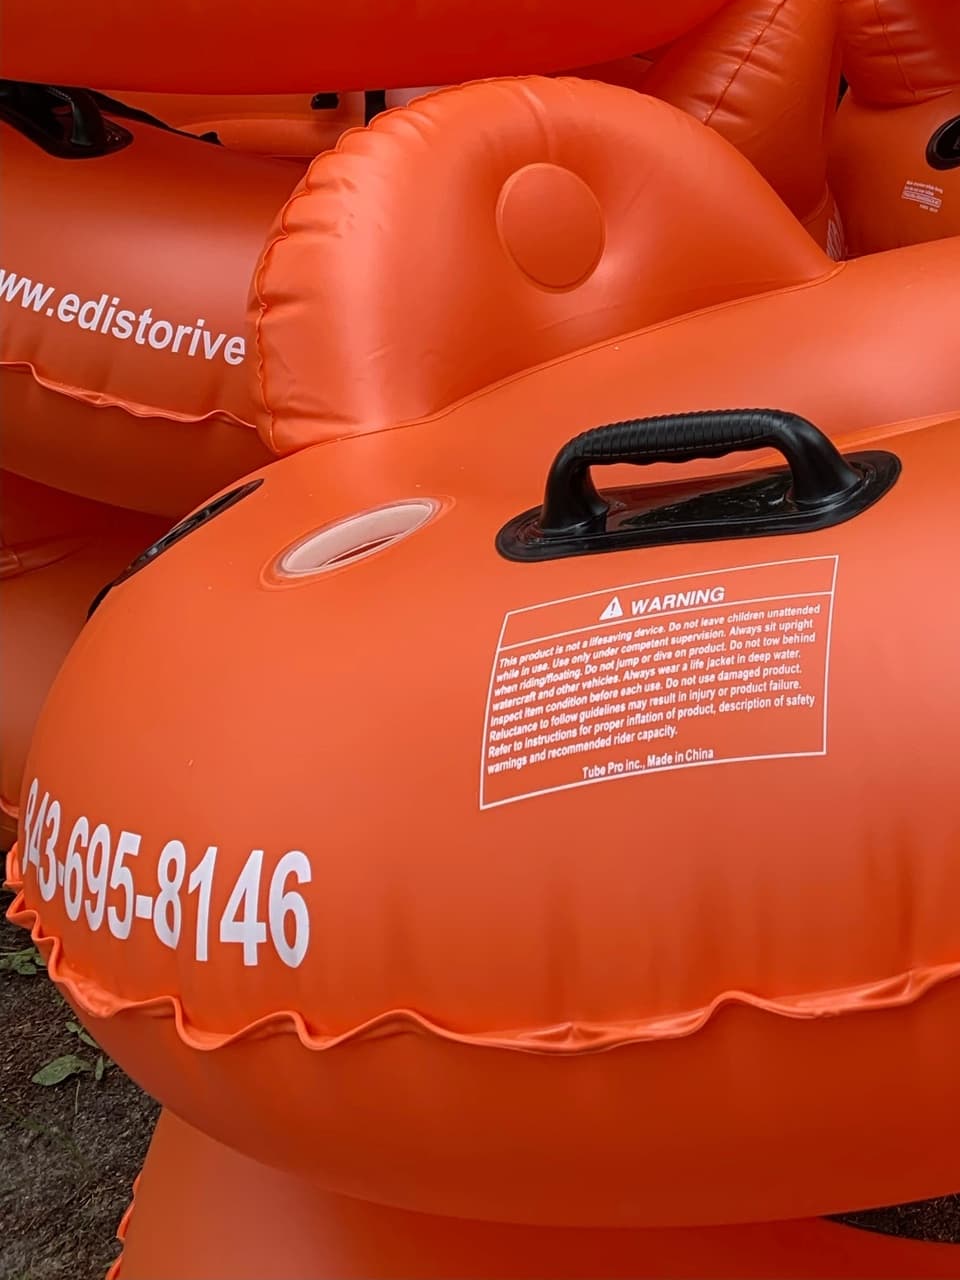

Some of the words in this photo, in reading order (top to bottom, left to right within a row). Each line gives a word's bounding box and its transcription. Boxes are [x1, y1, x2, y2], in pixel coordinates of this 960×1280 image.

[631, 587, 725, 615] WARNING
[495, 683, 517, 696] when
[585, 664, 597, 675] Do
[600, 662, 614, 671] not
[616, 657, 639, 669] jump
[642, 655, 651, 663] or
[654, 650, 672, 660] dive
[675, 649, 686, 658] on
[730, 640, 742, 650] Do
[745, 639, 760, 648] not
[763, 638, 780, 646] tow
[783, 633, 815, 644] behind
[497, 669, 519, 682] while
[521, 666, 529, 676] in
[552, 658, 569, 668] Use
[572, 653, 590, 664] only
[593, 647, 618, 660] under
[621, 638, 668, 654] competent
[729, 625, 762, 638] Always
[764, 622, 776, 632] sit
[779, 619, 813, 632] upright
[500, 656, 517, 668] This
[519, 649, 553, 664] product
[555, 646, 563, 654] is
[565, 643, 580, 652] not
[590, 631, 632, 647] lifesaving
[669, 622, 681, 632] Do
[684, 620, 698, 629] not
[701, 617, 724, 626] leave
[728, 610, 764, 623] children
[767, 604, 820, 618] unattended
[493, 692, 536, 711] watercraft
[538, 688, 554, 699] and
[556, 682, 579, 695] other
[623, 667, 655, 681] Always
[658, 662, 679, 675] wear
[690, 659, 704, 669] life
[706, 655, 735, 669] jacket
[737, 654, 745, 663] in
[748, 650, 770, 662] deep
[546, 696, 587, 712] condition
[590, 689, 618, 703] before
[620, 684, 642, 697] each
[666, 678, 678, 689] Do
[681, 675, 696, 685] not
[699, 675, 715, 683] use
[718, 668, 760, 681] damaged
[488, 744, 512, 758] Refer
[514, 741, 522, 750] to
[525, 730, 577, 750] instructions
[579, 724, 592, 735] for
[594, 719, 625, 733] proper
[627, 710, 663, 725] inflation
[666, 708, 676, 719] of
[719, 697, 771, 712] description
[774, 695, 784, 707] of
[786, 694, 815, 708] safety
[490, 724, 537, 742] Reluctance
[540, 720, 549, 728] to
[551, 714, 578, 726] follow
[579, 704, 625, 722] guidelines
[628, 700, 647, 713] may
[650, 691, 676, 705] result
[679, 690, 687, 699] in
[689, 686, 715, 701] injury
[718, 687, 728, 696] or
[731, 682, 767, 698] product
[488, 755, 527, 775] warnings
[530, 749, 546, 763] and
[548, 735, 611, 759] recommended
[613, 731, 635, 744] rider
[583, 767, 605, 779] Tube
[608, 762, 623, 774] Pro
[647, 752, 673, 767] Made
[675, 752, 683, 762] in
[685, 748, 714, 762] China
